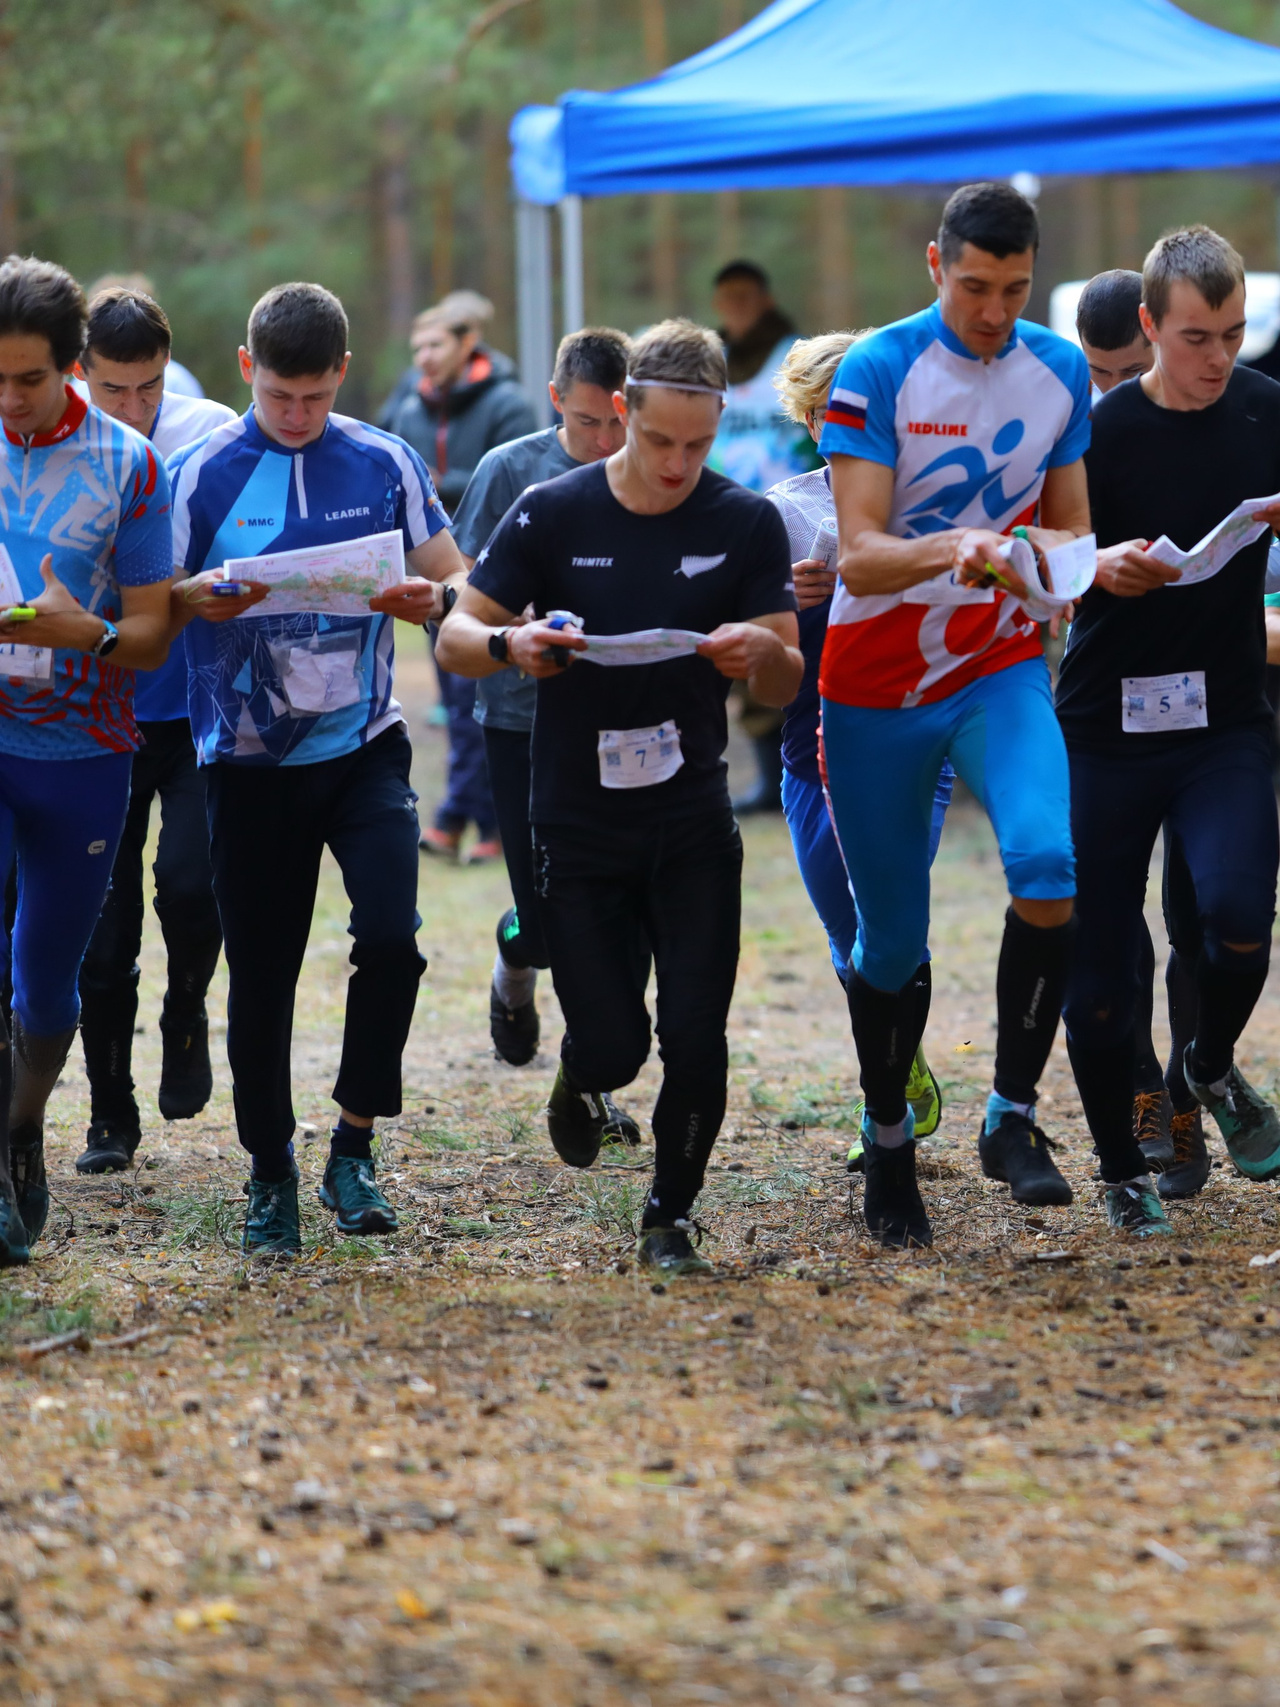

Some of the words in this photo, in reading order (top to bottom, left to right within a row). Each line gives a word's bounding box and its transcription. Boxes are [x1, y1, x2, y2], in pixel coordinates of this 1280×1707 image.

[908, 421, 968, 437] REDLINE
[325, 506, 370, 521] LEADER
[247, 518, 275, 527] MMC
[572, 557, 614, 567] TRIMTEX
[1159, 695, 1170, 714] 5
[635, 748, 647, 768] 7
